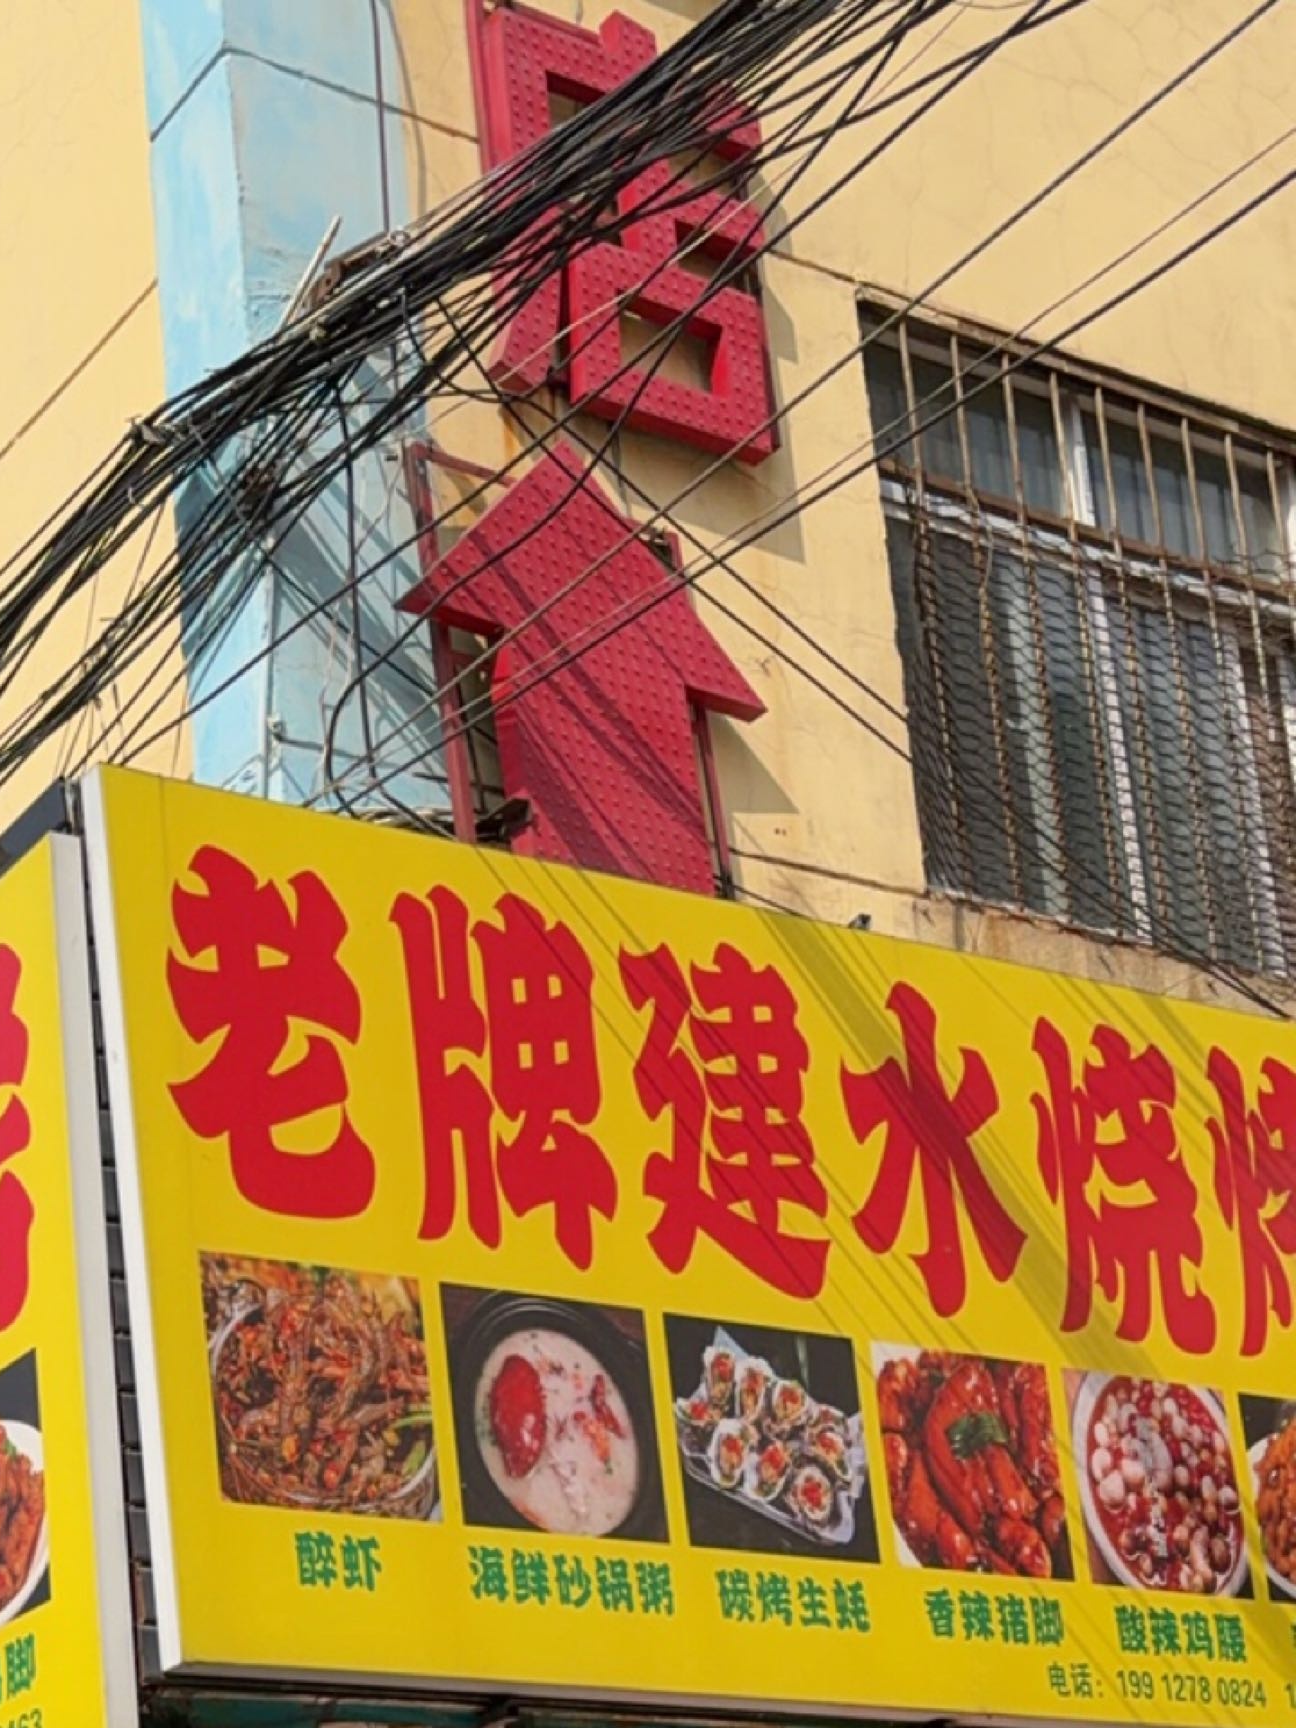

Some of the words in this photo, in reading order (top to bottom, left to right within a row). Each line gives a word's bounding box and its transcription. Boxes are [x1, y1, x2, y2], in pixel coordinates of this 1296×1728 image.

[295, 1531, 382, 1591] 醉虾
[468, 1545, 675, 1616] 海鲜砂锅粥
[715, 1568, 871, 1633] 碳烤生蚝
[925, 1588, 1065, 1646] 香辣猪脚
[1115, 1604, 1248, 1663] 酸辣鸡腰
[1116, 1669, 1153, 1700] 199
[1161, 1673, 1211, 1704] 1278
[1216, 1676, 1267, 1708] 0824
